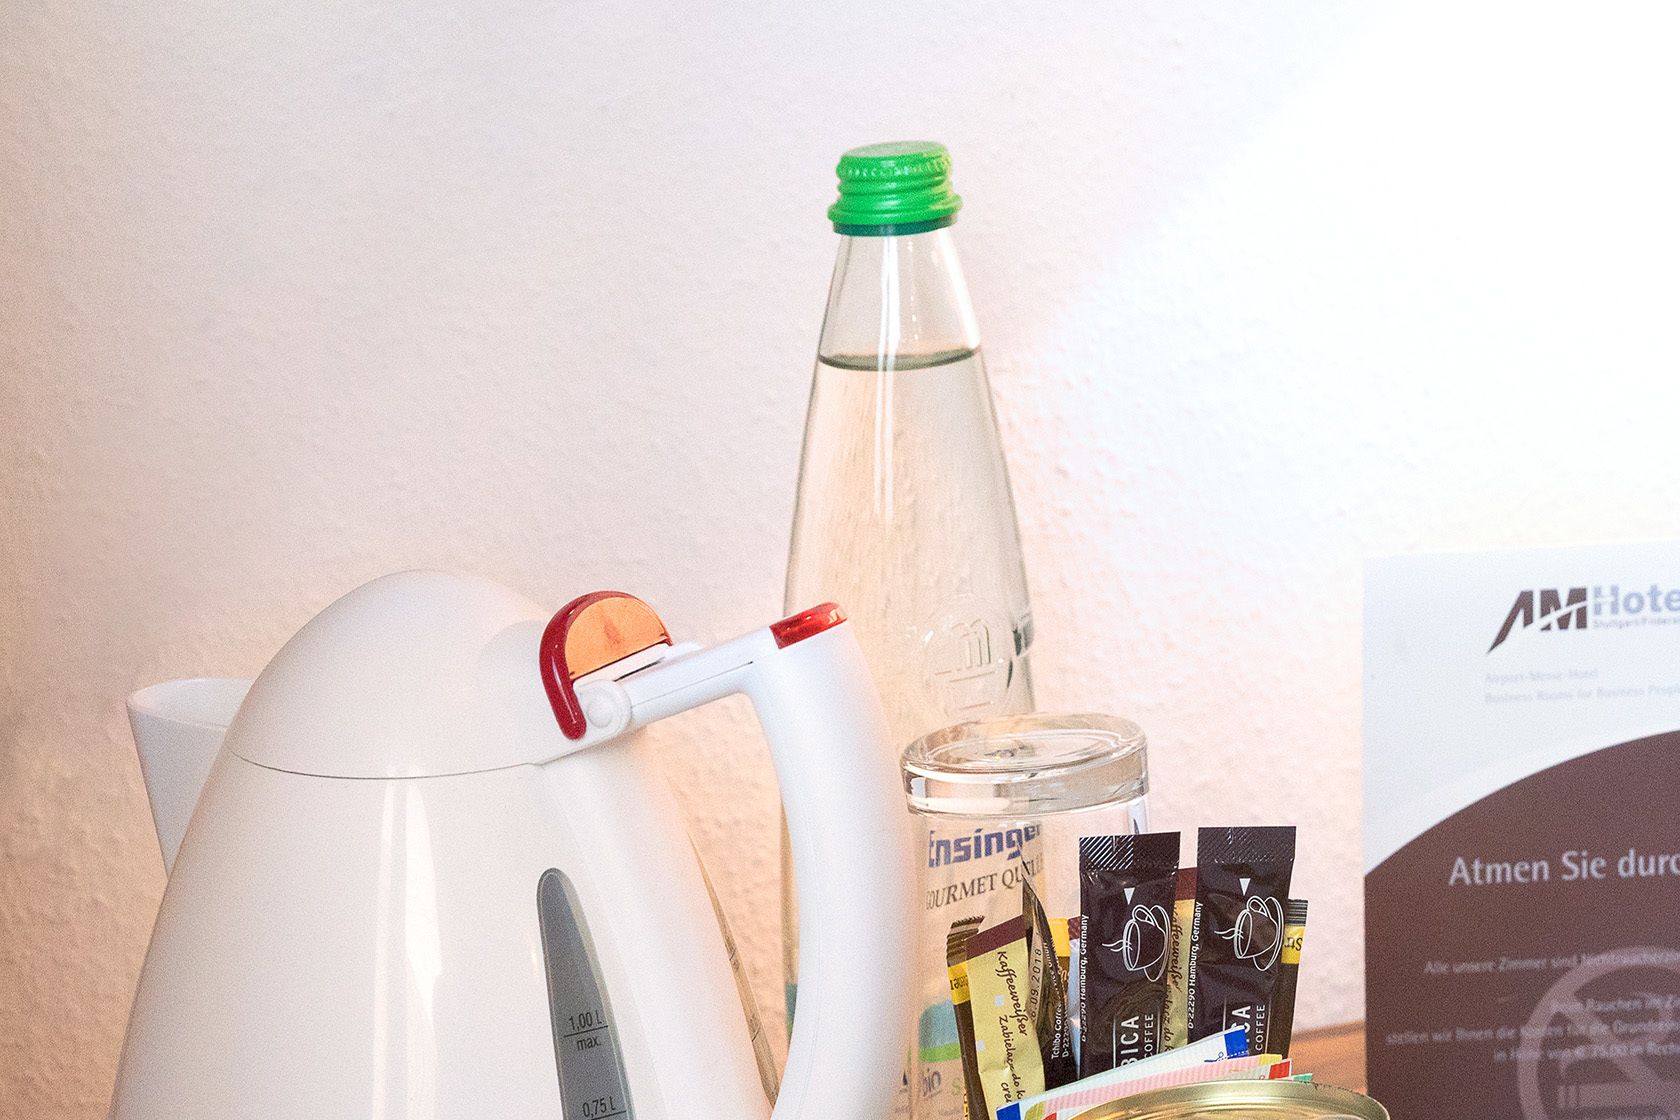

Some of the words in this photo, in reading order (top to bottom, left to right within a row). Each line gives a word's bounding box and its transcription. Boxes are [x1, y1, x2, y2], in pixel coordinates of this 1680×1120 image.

[1486, 586, 1588, 656] AM
[1448, 856, 1551, 886] Atmen
[1561, 850, 1607, 881] Sie
[1080, 914, 1090, 955] Germany
[1192, 902, 1204, 942] Germany
[1189, 945, 1200, 987] Hamburg,
[1498, 955, 1547, 972] Zimmer
[995, 951, 1028, 1036] Kaffeeweißer
[569, 1011, 593, 1031] 1,00
[1255, 1004, 1266, 1051] COFFEE
[576, 1035, 602, 1052] max.
[1051, 1032, 1062, 1059] Tchibo
[582, 1097, 607, 1119] 0,75
